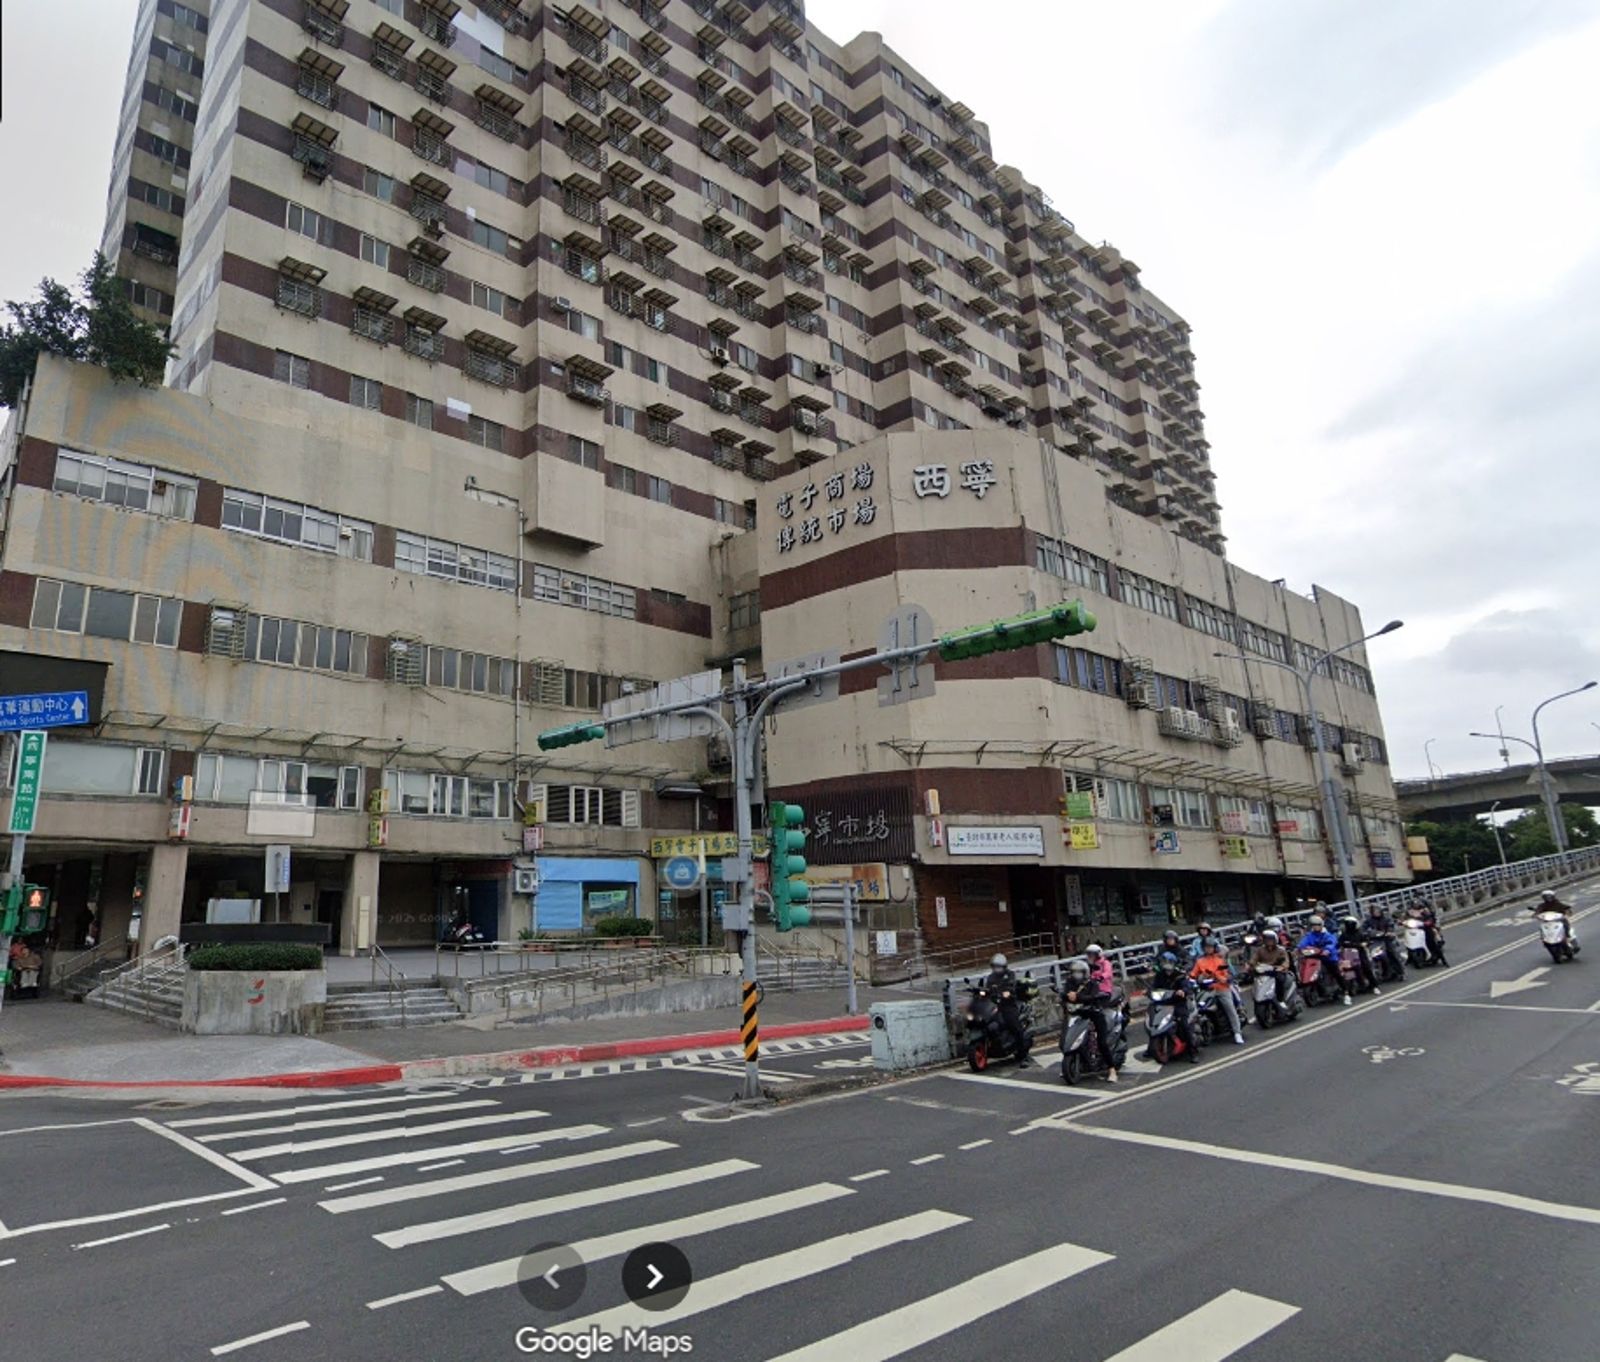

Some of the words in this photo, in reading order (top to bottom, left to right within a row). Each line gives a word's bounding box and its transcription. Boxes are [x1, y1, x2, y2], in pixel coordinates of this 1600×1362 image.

[776, 462, 876, 519] 電子商場
[913, 459, 998, 499] 西寧
[776, 497, 878, 553] 傳統市場
[19, 715, 44, 726] Sports
[45, 713, 70, 722] Center
[796, 809, 890, 845] 寧市場
